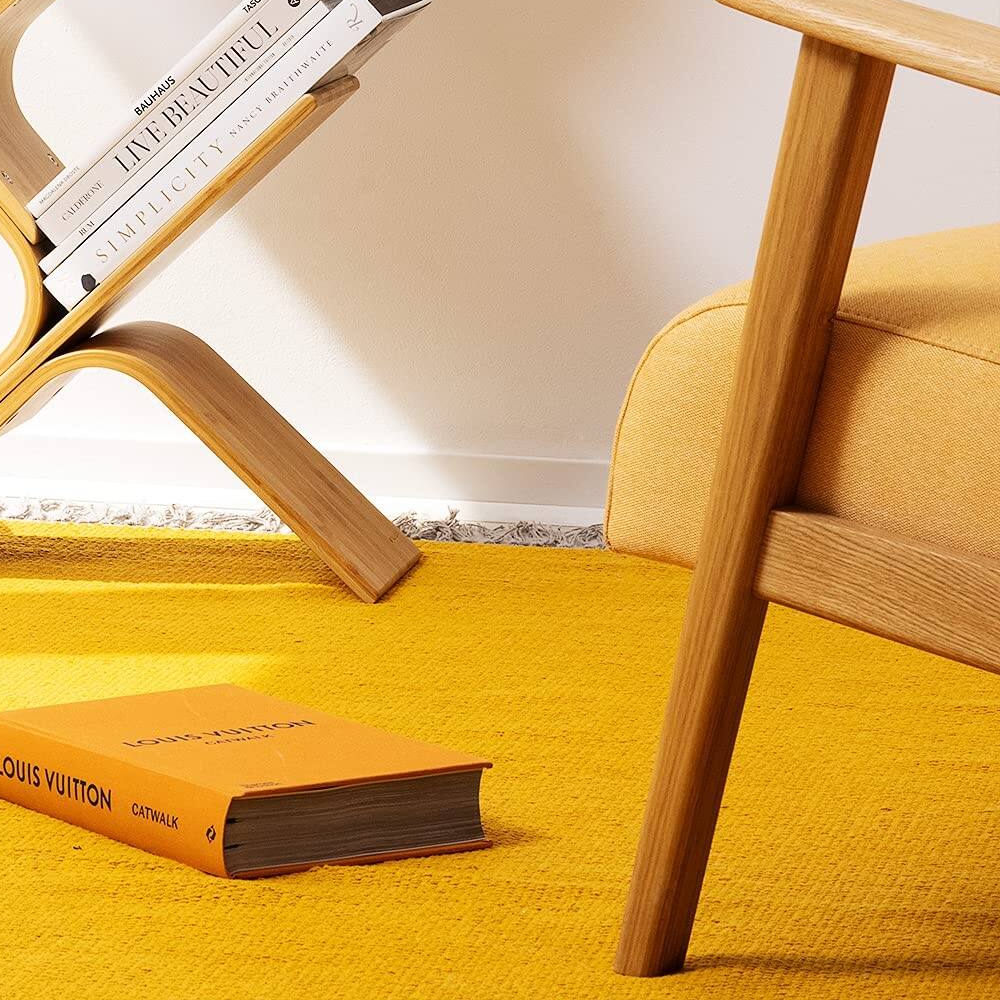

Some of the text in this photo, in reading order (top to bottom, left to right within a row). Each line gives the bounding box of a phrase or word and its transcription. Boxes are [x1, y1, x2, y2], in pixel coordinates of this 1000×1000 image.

[134, 75, 177, 117] BAUHAUS
[61, 180, 105, 223] CALDERONE
[113, 119, 168, 174] LIVE
[167, 20, 280, 129] BEAUTIFUL
[95, 137, 225, 264] SIMPLICITY
[228, 105, 264, 138] NANCY
[266, 38, 334, 104] BRAITHWAITE
[122, 719, 316, 748] LOUIS VUITTON
[205, 734, 275, 745] CATWALK
[44, 768, 112, 812] VUITTON
[130, 802, 179, 831] CATWALK
